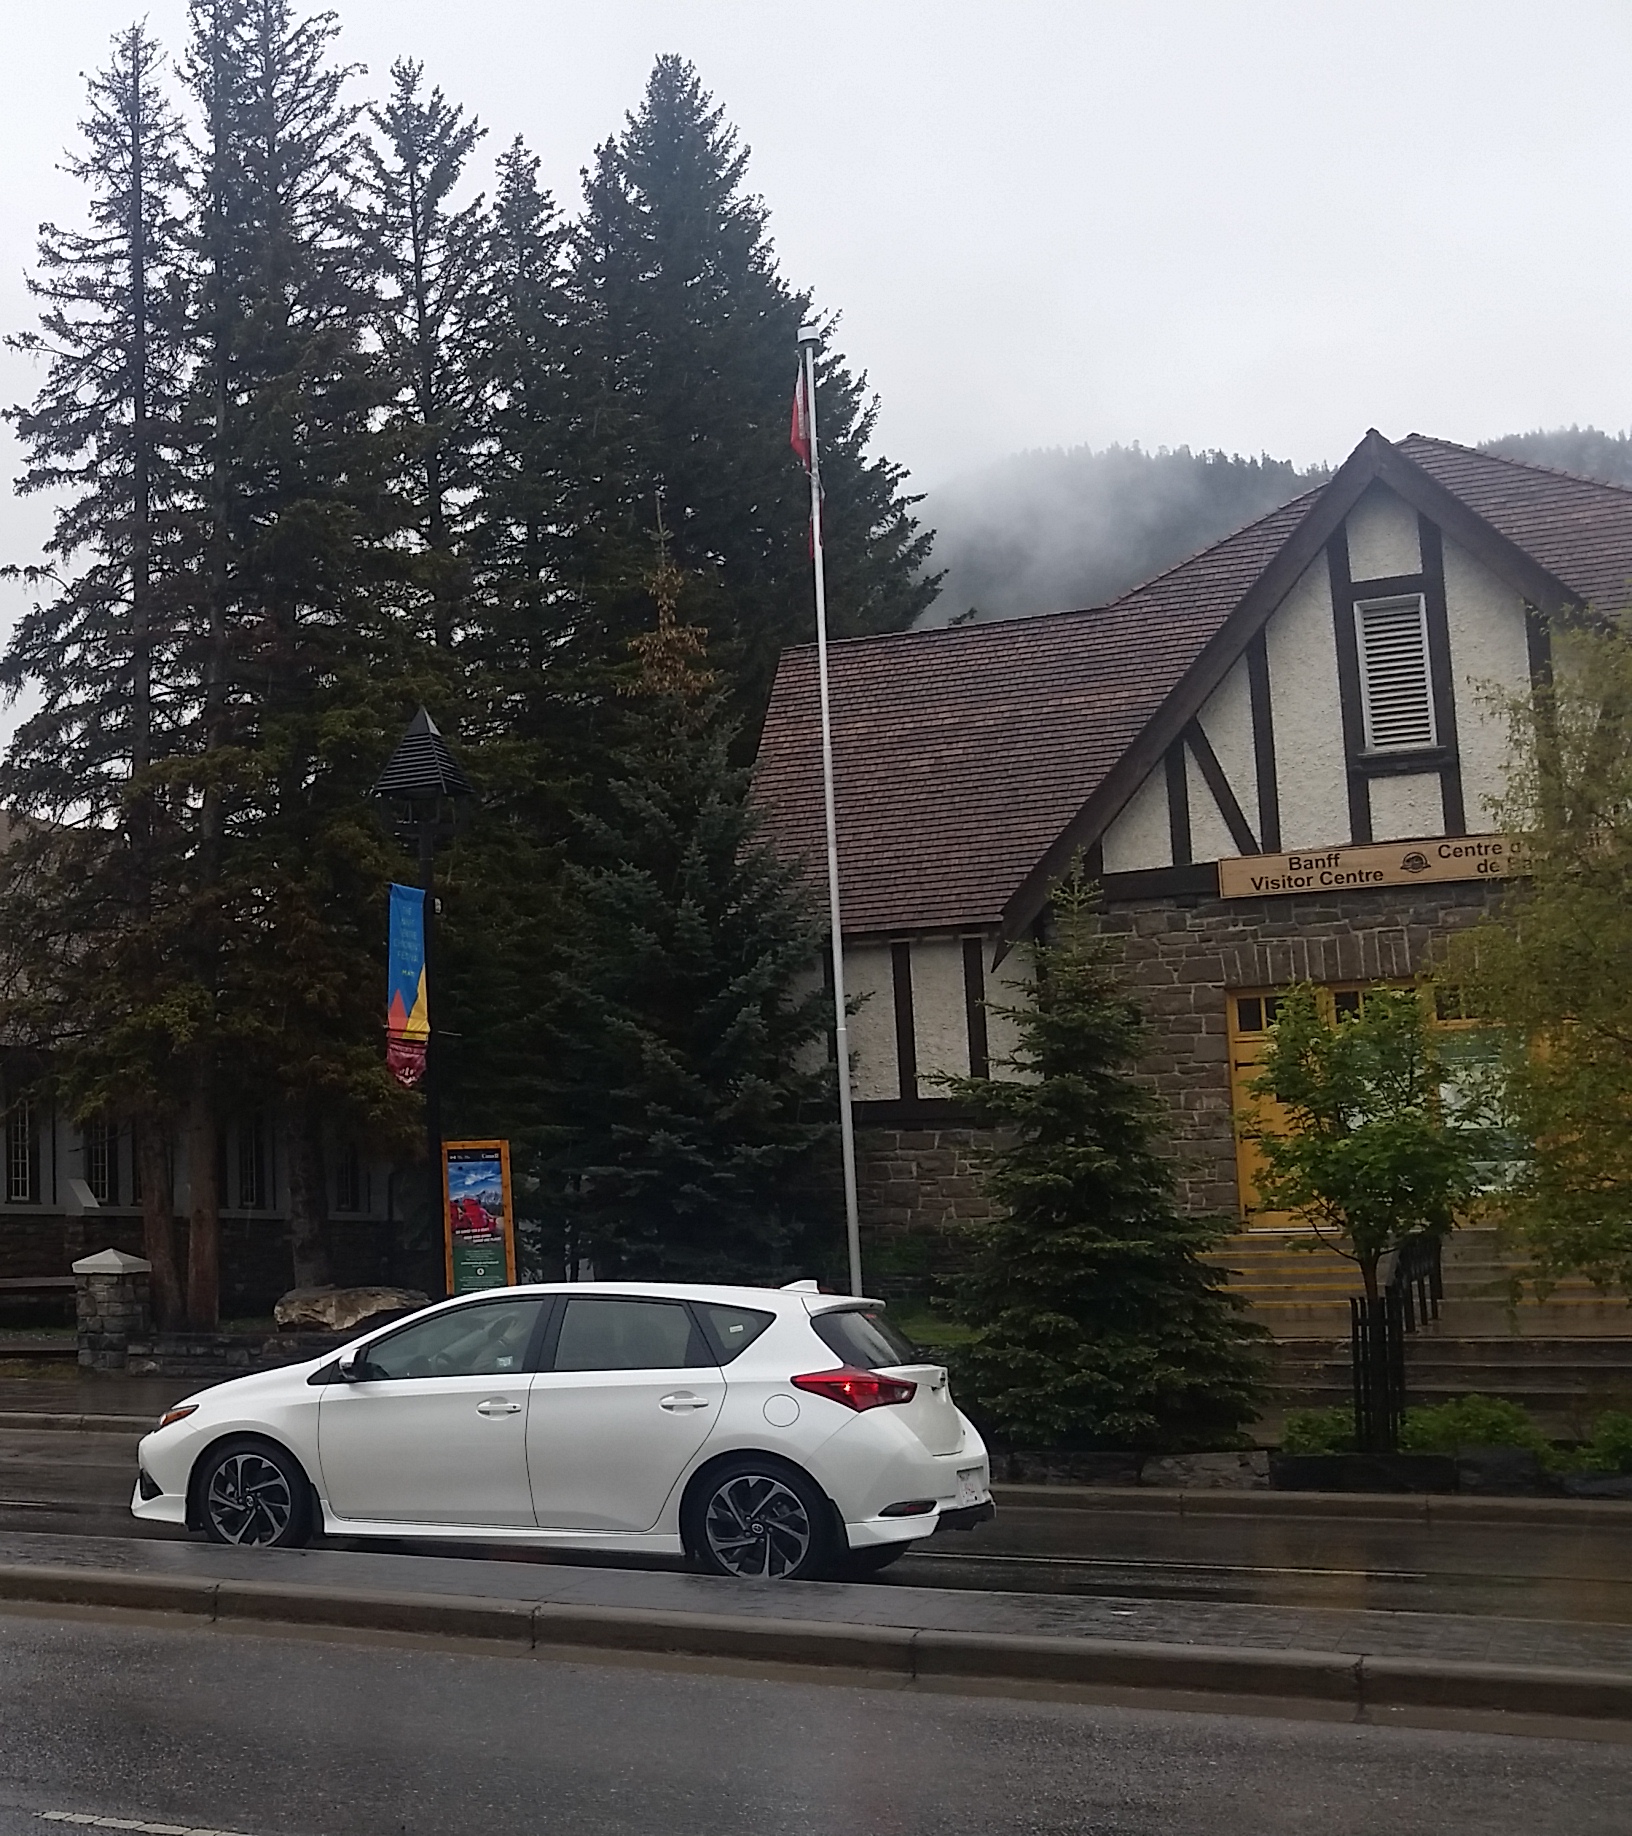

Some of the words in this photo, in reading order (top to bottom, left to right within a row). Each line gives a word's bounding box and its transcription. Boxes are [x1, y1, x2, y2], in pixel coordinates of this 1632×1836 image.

[1437, 842, 1503, 859] Centre
[1288, 853, 1341, 871] Banff
[1476, 858, 1500, 873] de
[1250, 874, 1314, 891] Visitor
[1319, 869, 1384, 886] Centre
